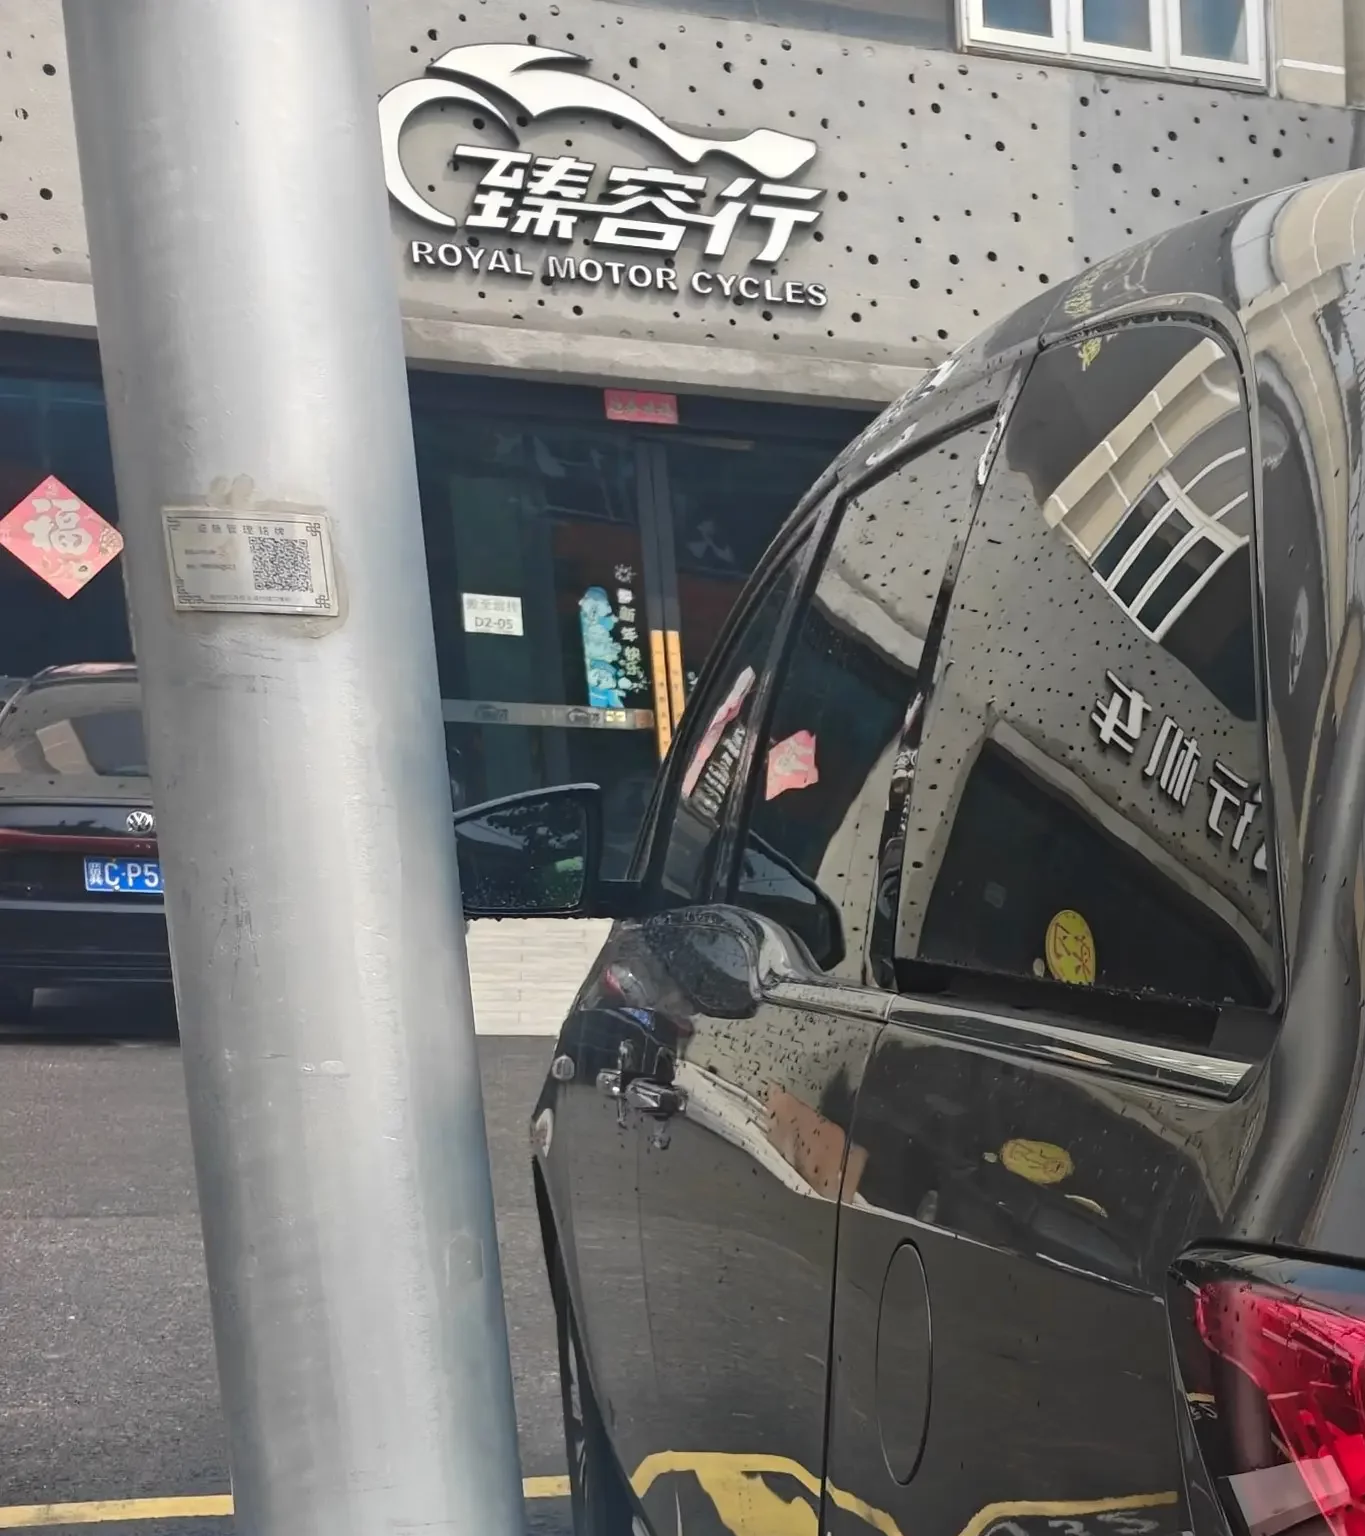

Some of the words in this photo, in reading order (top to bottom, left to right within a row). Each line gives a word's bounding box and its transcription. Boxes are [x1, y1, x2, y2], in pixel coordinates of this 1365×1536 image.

[453, 142, 828, 265] 臻容行
[411, 240, 535, 277] ROYAL
[548, 254, 679, 291] MOTOR
[691, 270, 829, 307] CYCLES
[22, 497, 93, 556] 福
[88, 861, 165, 889] 冀C·P5
